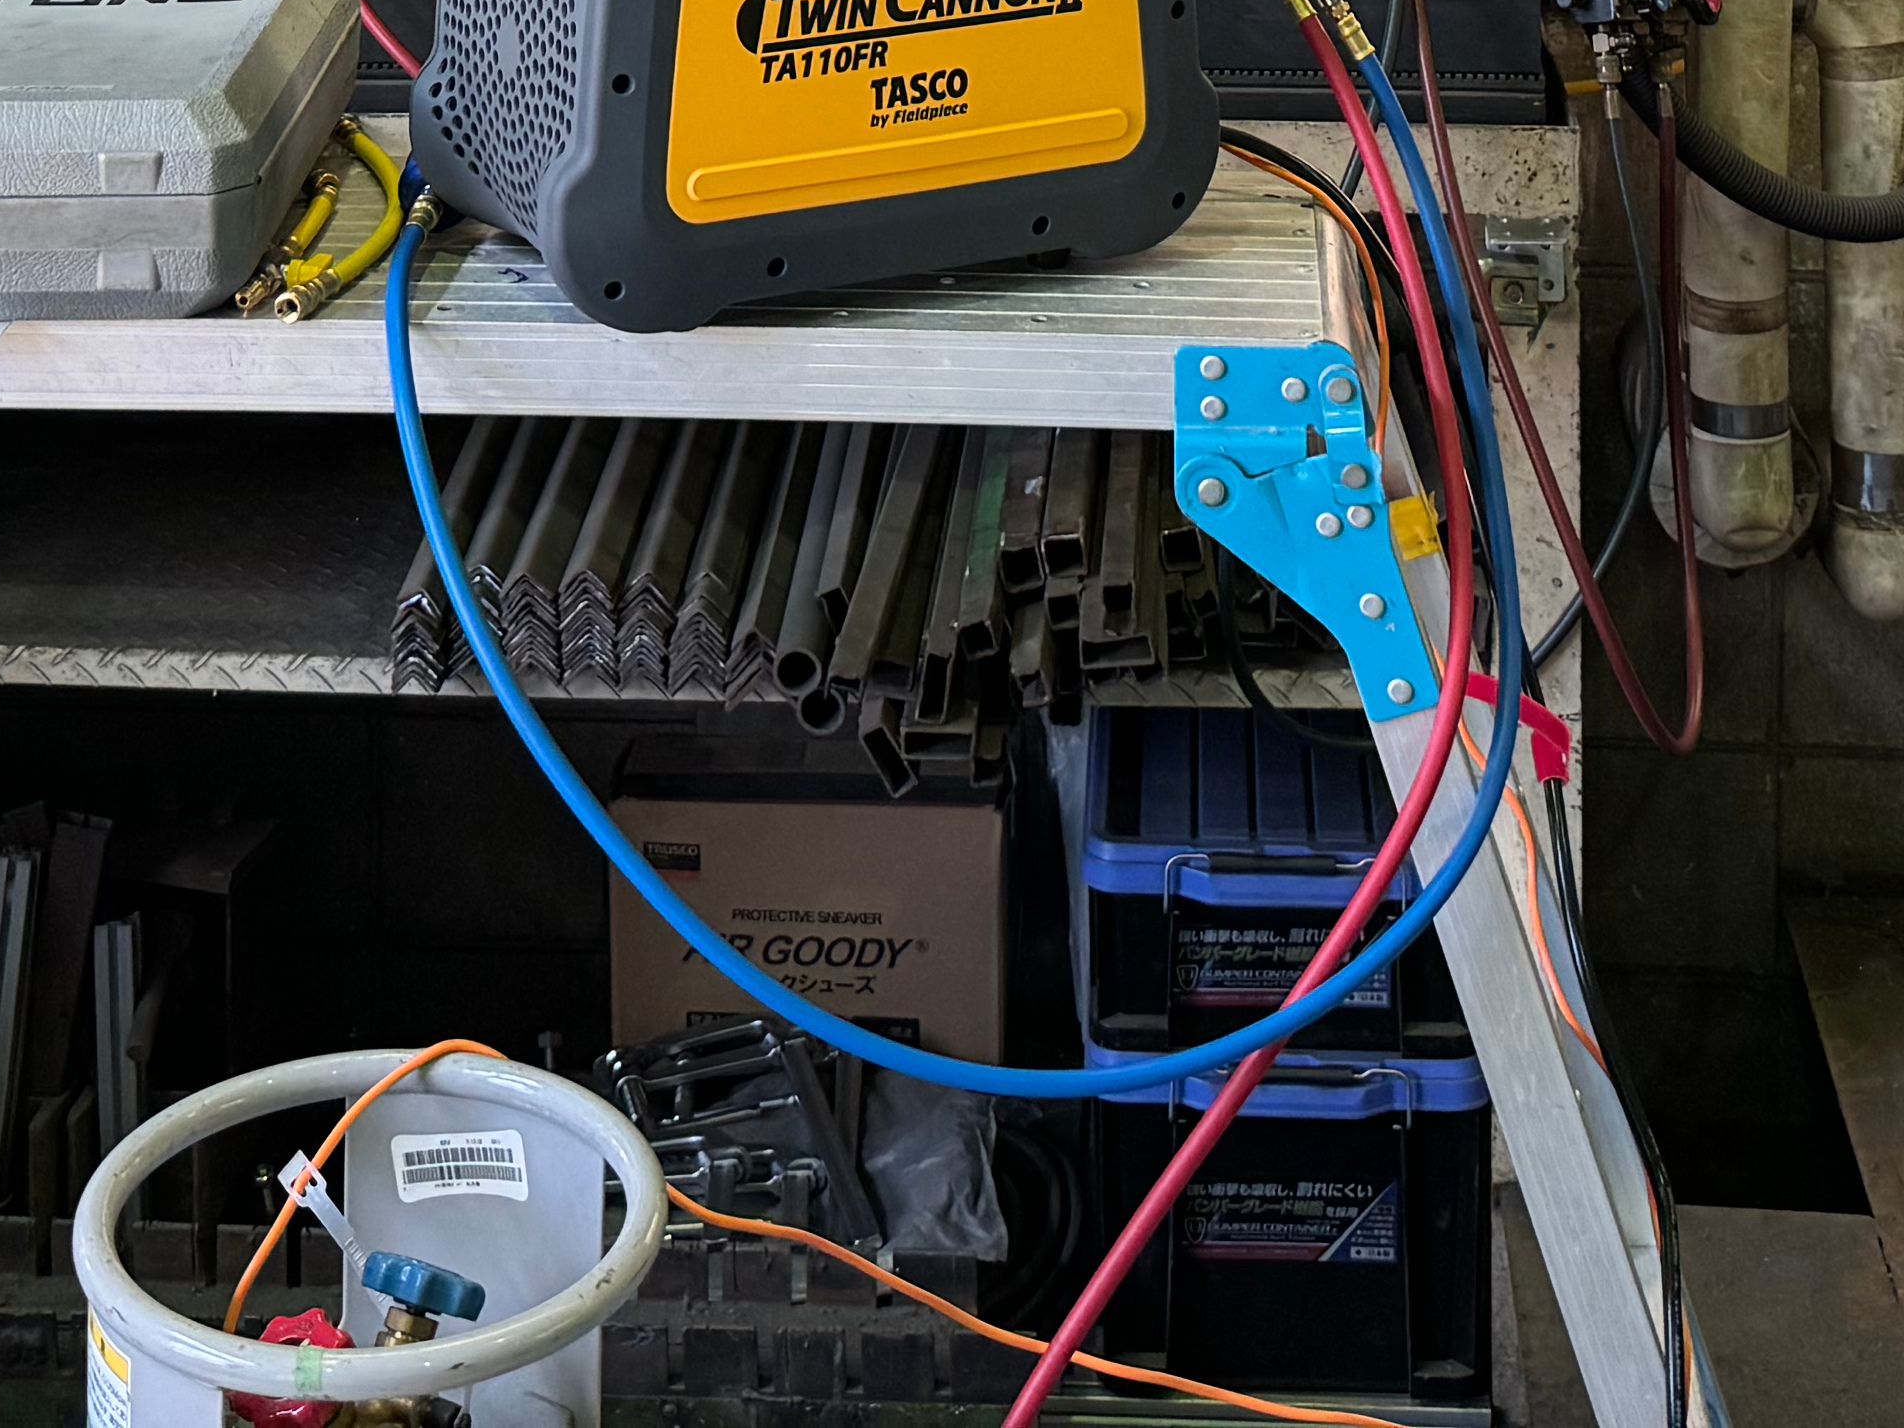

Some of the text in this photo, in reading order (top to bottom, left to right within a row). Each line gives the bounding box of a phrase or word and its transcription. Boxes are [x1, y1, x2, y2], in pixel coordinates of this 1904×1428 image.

[759, 40, 889, 84] TA110FR
[870, 68, 969, 111] TASCO
[870, 102, 969, 129] by Fieldpiece
[732, 908, 883, 926] PROTECTIVE SNEAKER
[762, 935, 914, 970] GOODY
